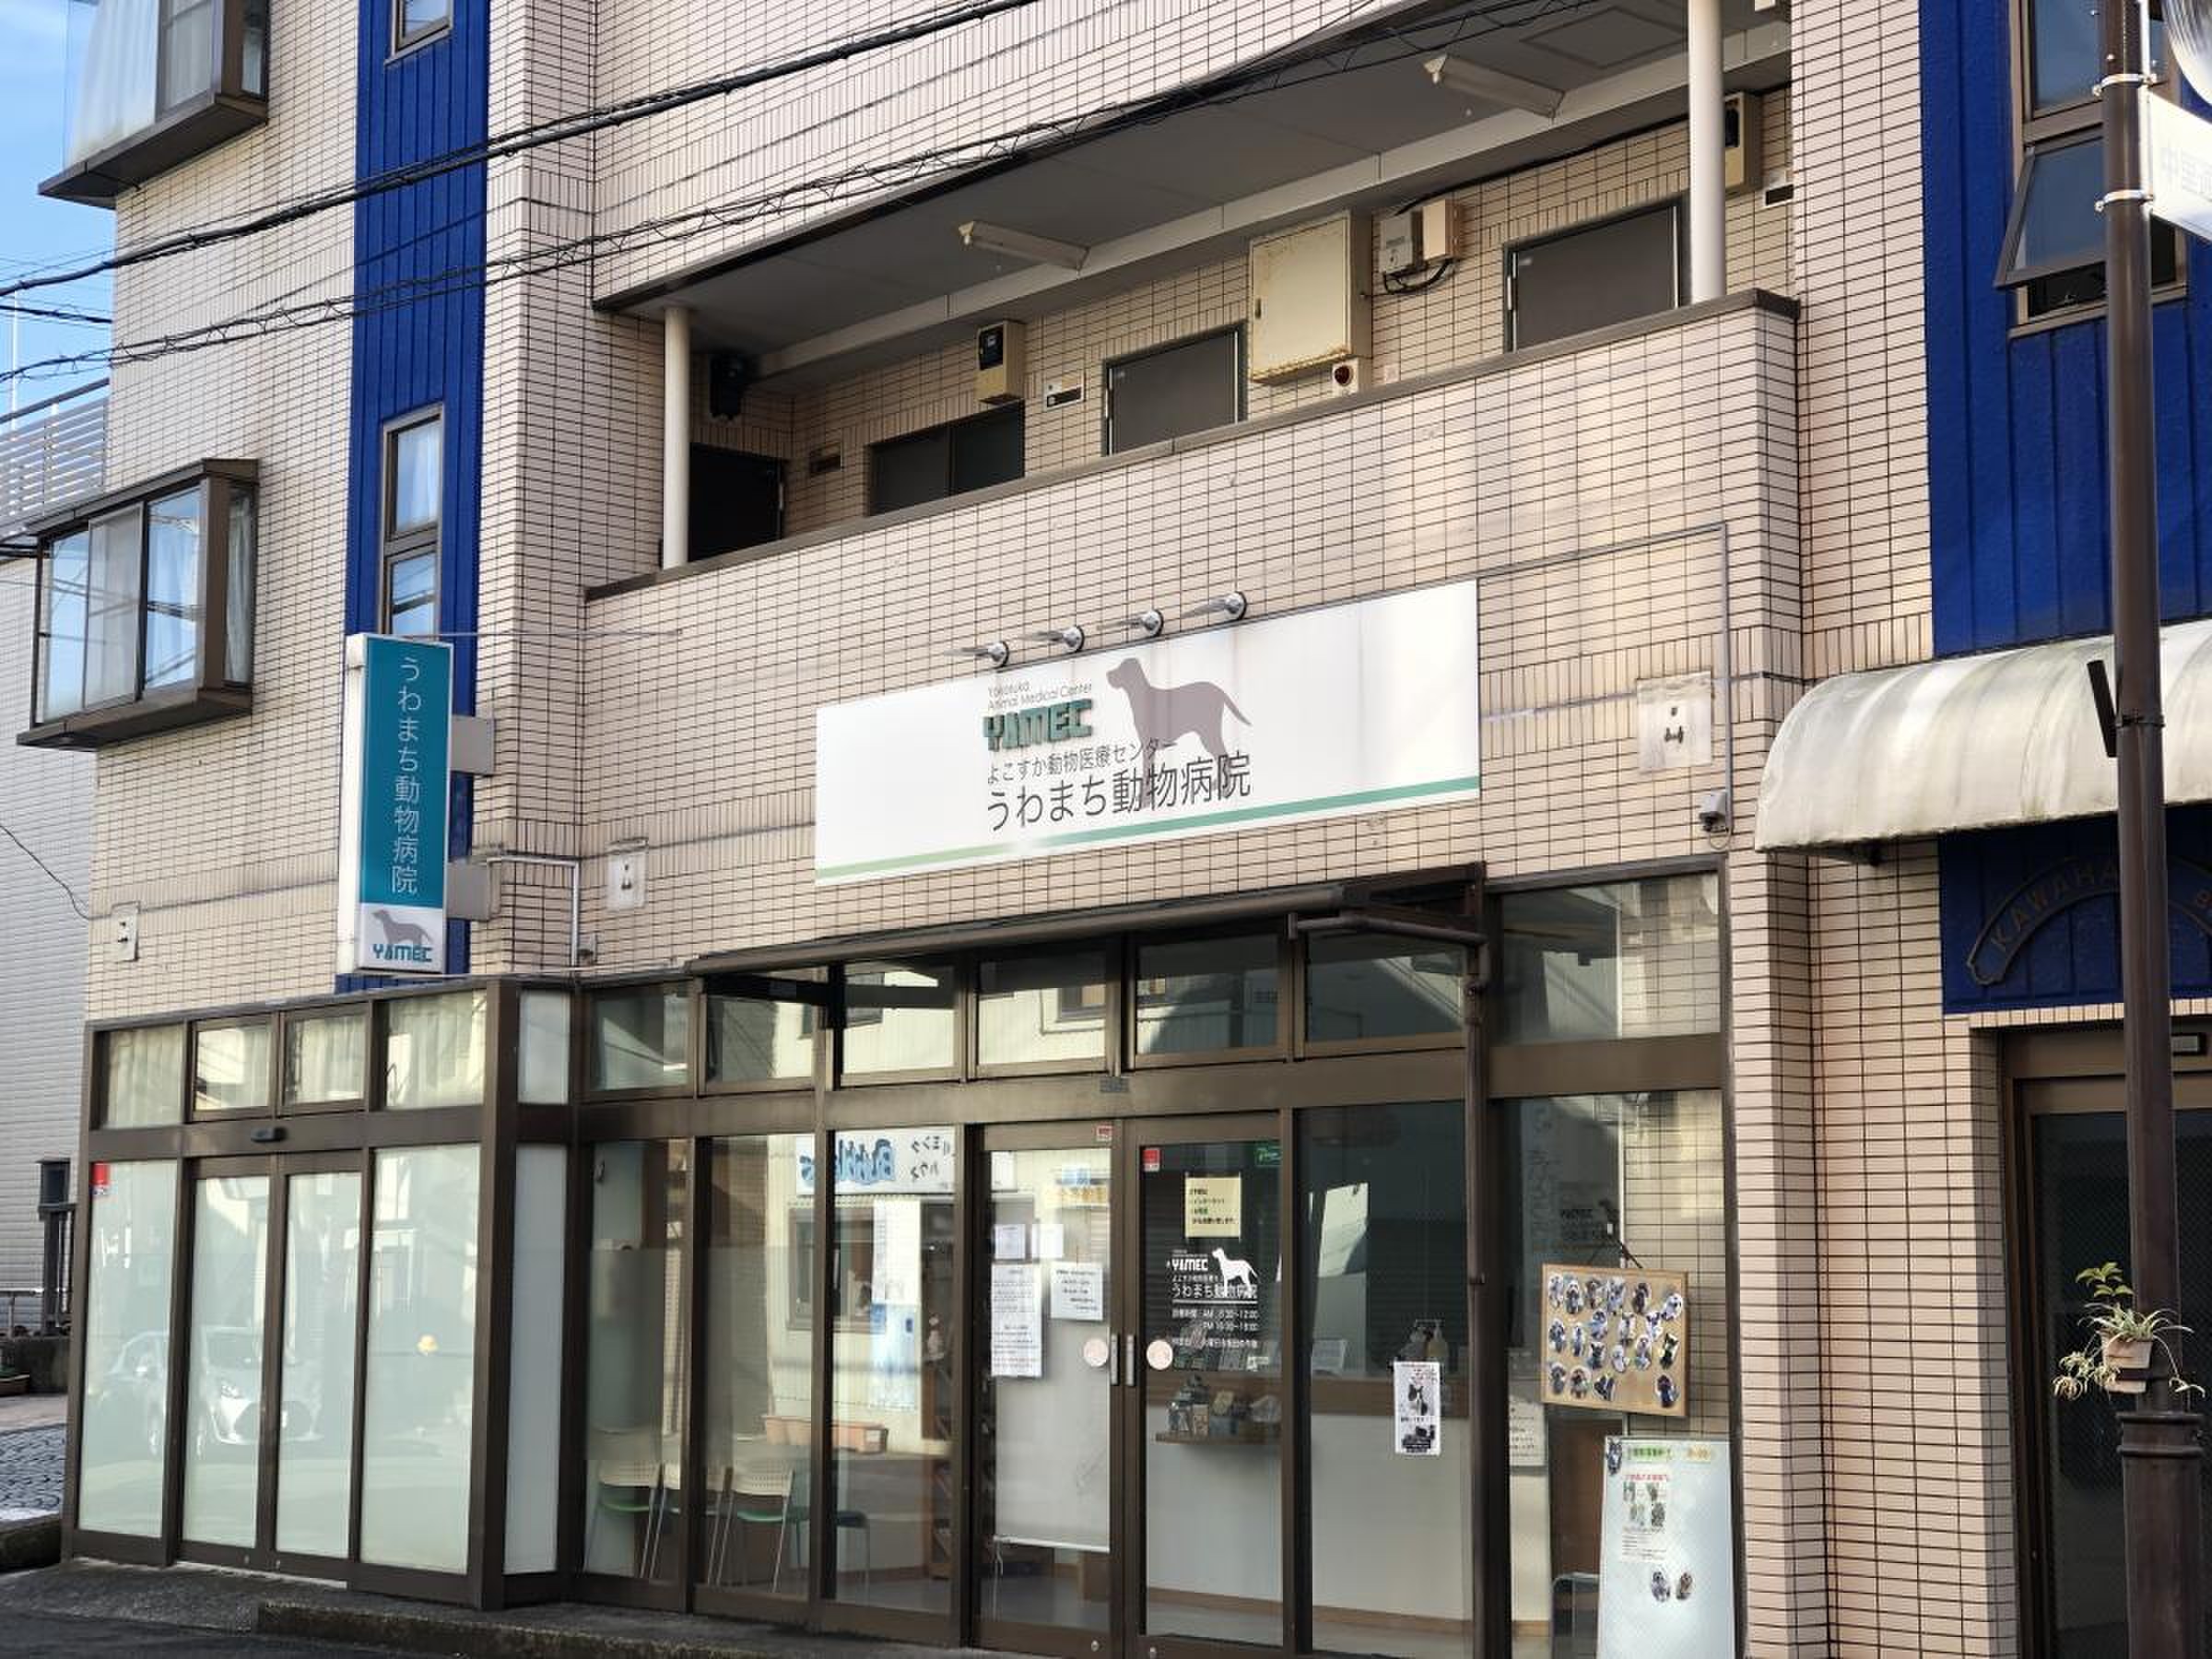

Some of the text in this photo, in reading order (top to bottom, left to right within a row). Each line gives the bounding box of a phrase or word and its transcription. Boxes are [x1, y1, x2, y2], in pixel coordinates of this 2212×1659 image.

[391, 656, 422, 896] うわまち動物病院
[988, 740, 1178, 785] よこすか動物医療センター
[988, 749, 1251, 832] うわまち動物病院
[372, 943, 432, 962] YAMEC
